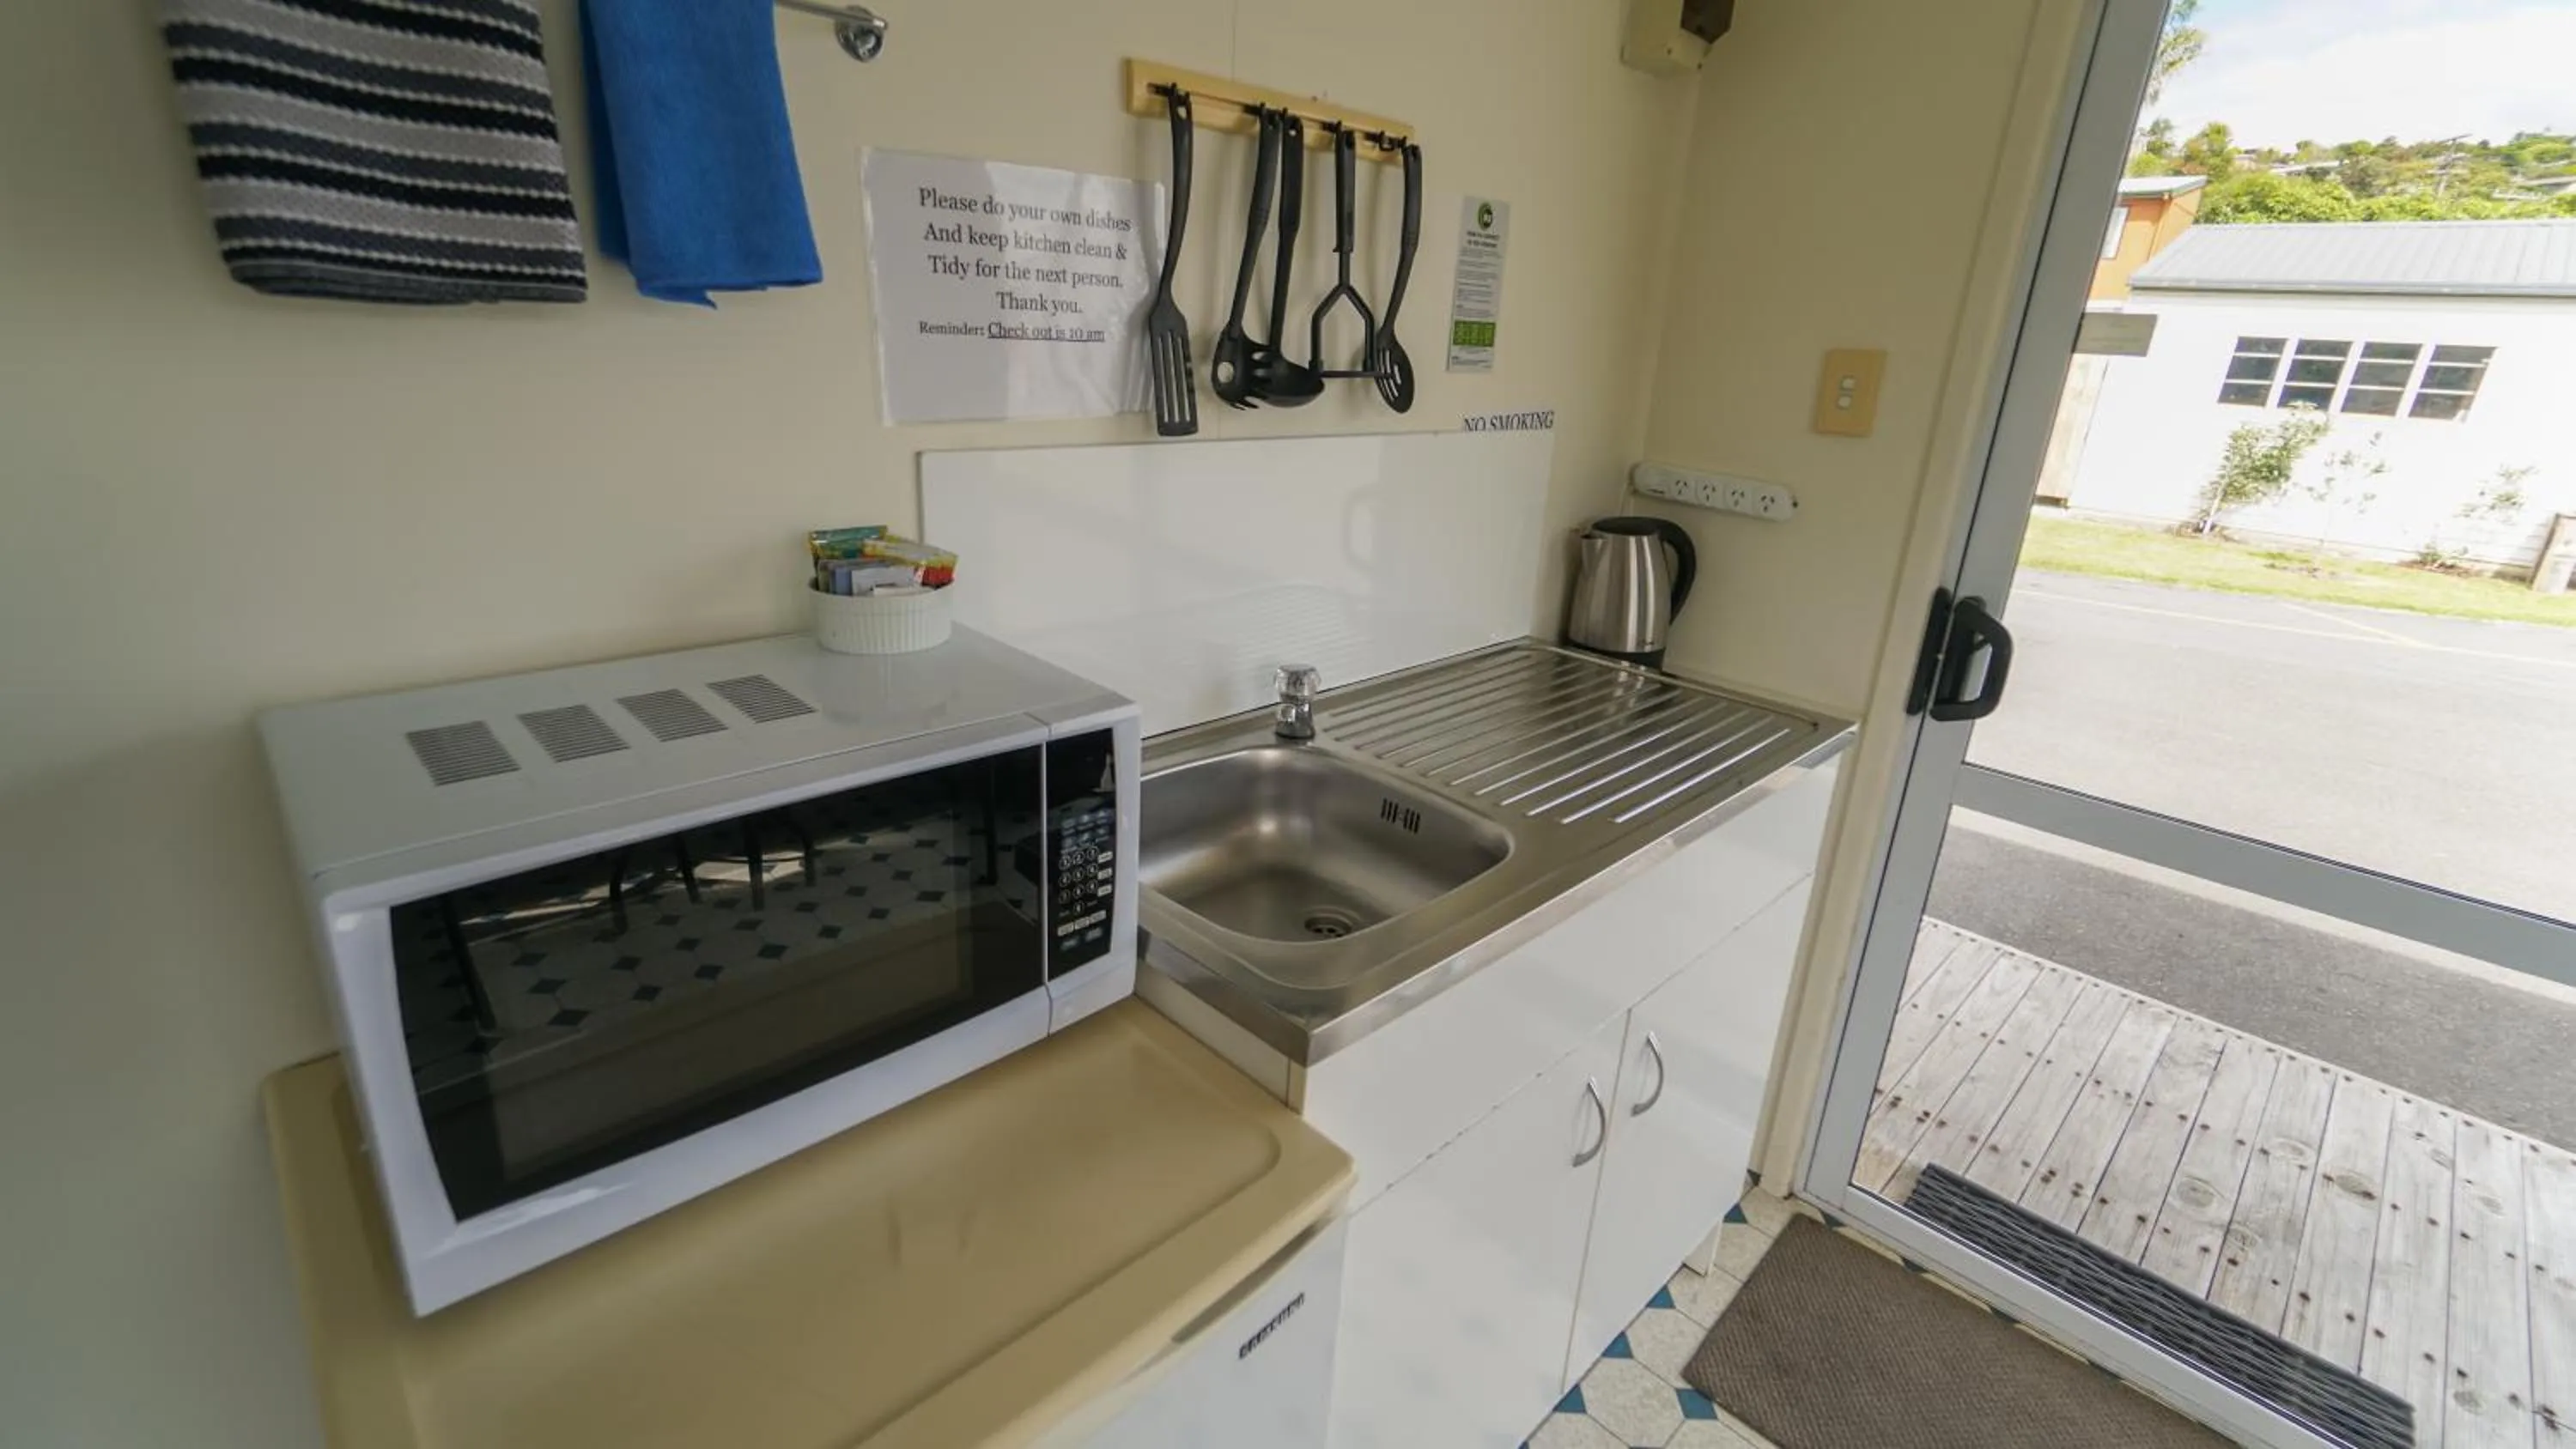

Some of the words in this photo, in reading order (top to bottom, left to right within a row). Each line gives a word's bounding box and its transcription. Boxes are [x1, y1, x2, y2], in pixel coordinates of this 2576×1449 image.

[920, 186, 978, 214] Please
[983, 194, 1005, 215] do
[1008, 203, 1047, 221] your
[1050, 209, 1082, 226] own
[1085, 208, 1133, 232] dishes
[923, 221, 962, 244] And
[968, 224, 1009, 252] keep
[1013, 229, 1071, 254] kitchen
[1074, 237, 1113, 258] clean
[1115, 242, 1127, 260] &
[927, 255, 970, 281] Tidy
[975, 258, 1000, 278] for
[1005, 260, 1031, 281] the
[1036, 267, 1067, 284] next
[1071, 272, 1123, 288] person.
[996, 290, 1048, 312] Thank
[1050, 299, 1084, 316] you.
[919, 321, 986, 336] Reminder:
[987, 322, 1030, 340] Check
[1030, 326, 1053, 340] out
[1054, 328, 1066, 340] is
[1068, 326, 1084, 341] 10
[1085, 328, 1106, 342] am
[1464, 415, 1486, 432] NO
[1490, 410, 1554, 432] SMOKING
